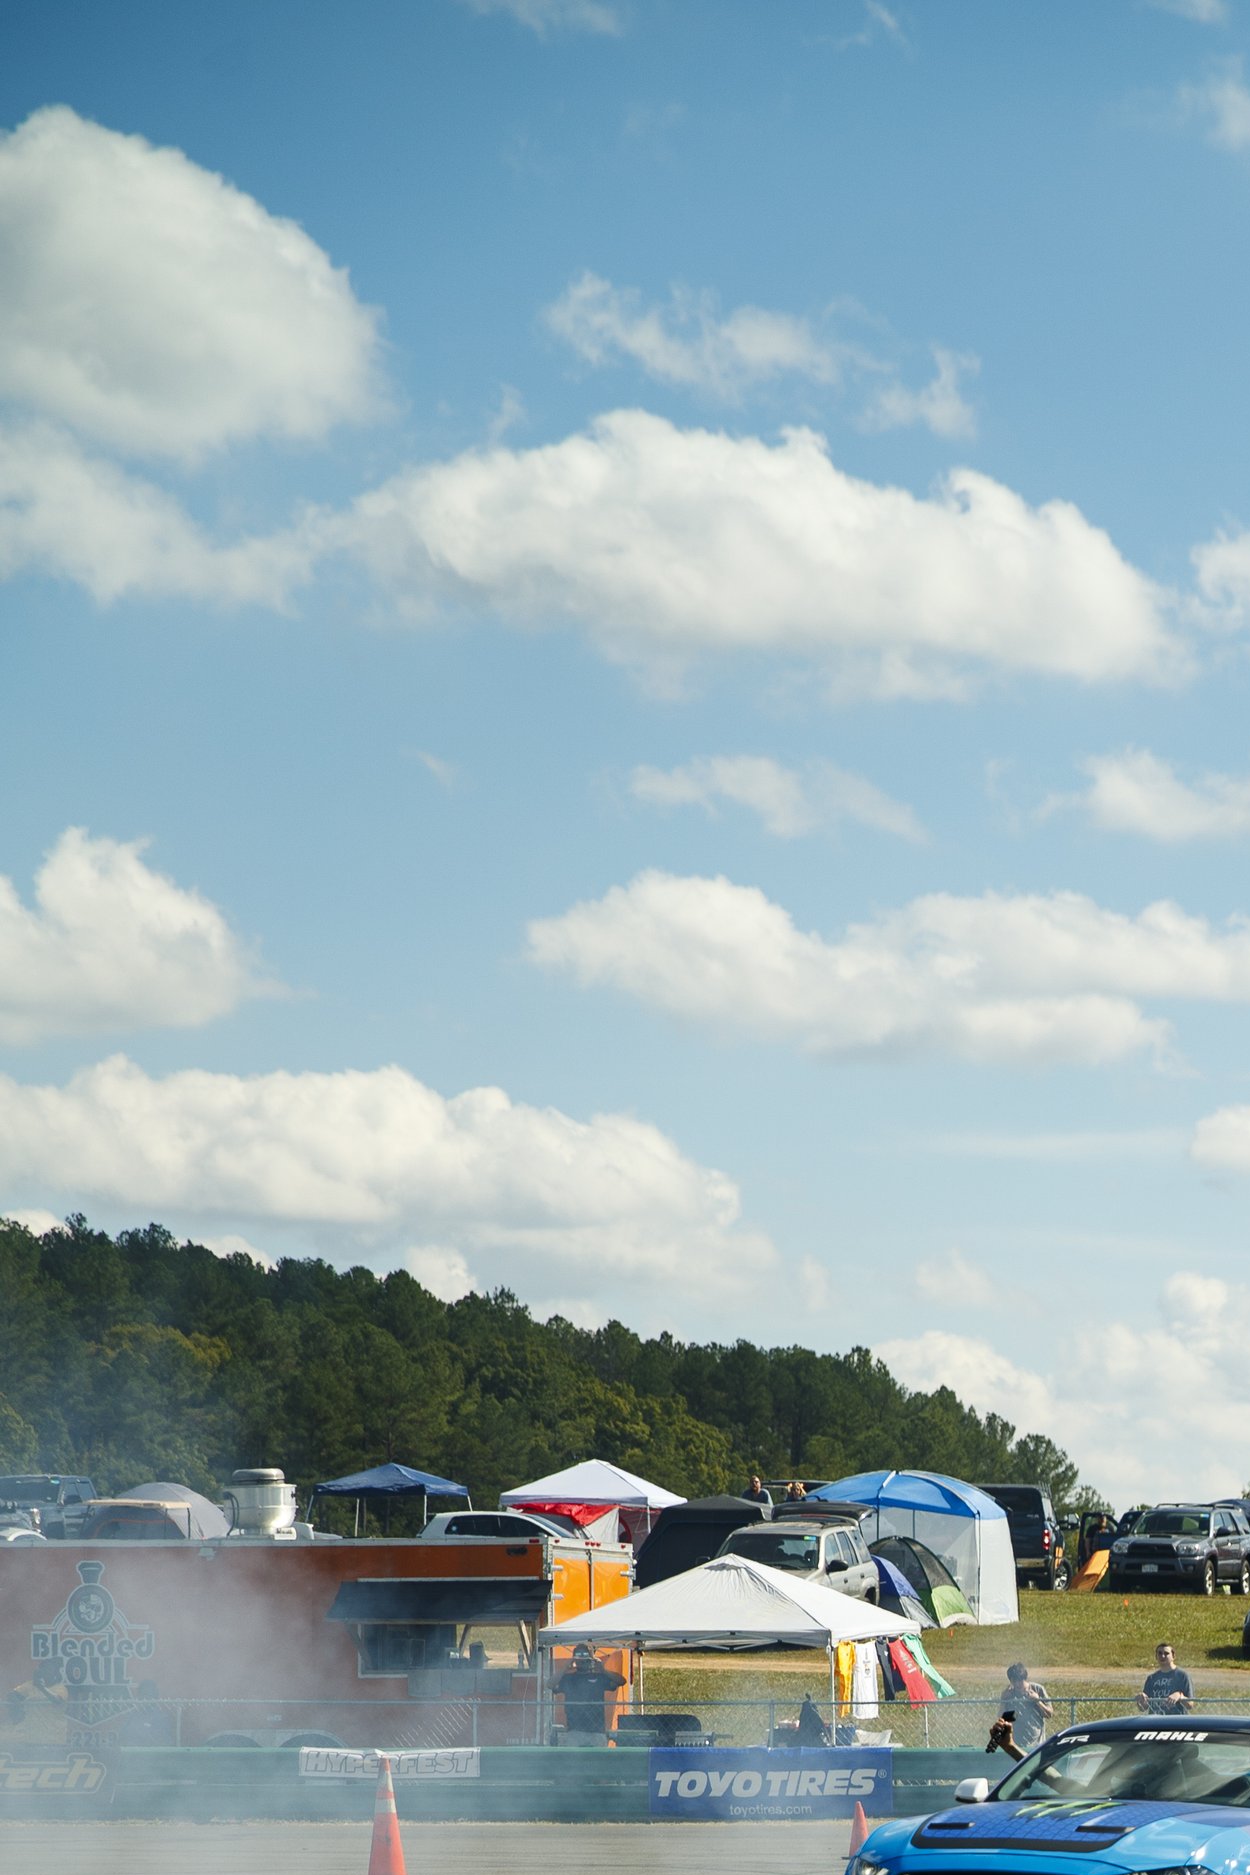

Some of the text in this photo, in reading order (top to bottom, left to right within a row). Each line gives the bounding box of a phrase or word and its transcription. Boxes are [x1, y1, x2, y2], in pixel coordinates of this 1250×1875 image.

[31, 1631, 155, 1660] Blended
[1153, 1677, 1173, 1688] ARE
[1152, 1689, 1171, 1698] YOU
[1134, 1731, 1208, 1742] MAHLE
[655, 1770, 763, 1798] TOYO
[729, 1803, 812, 1817] toyotires.com
